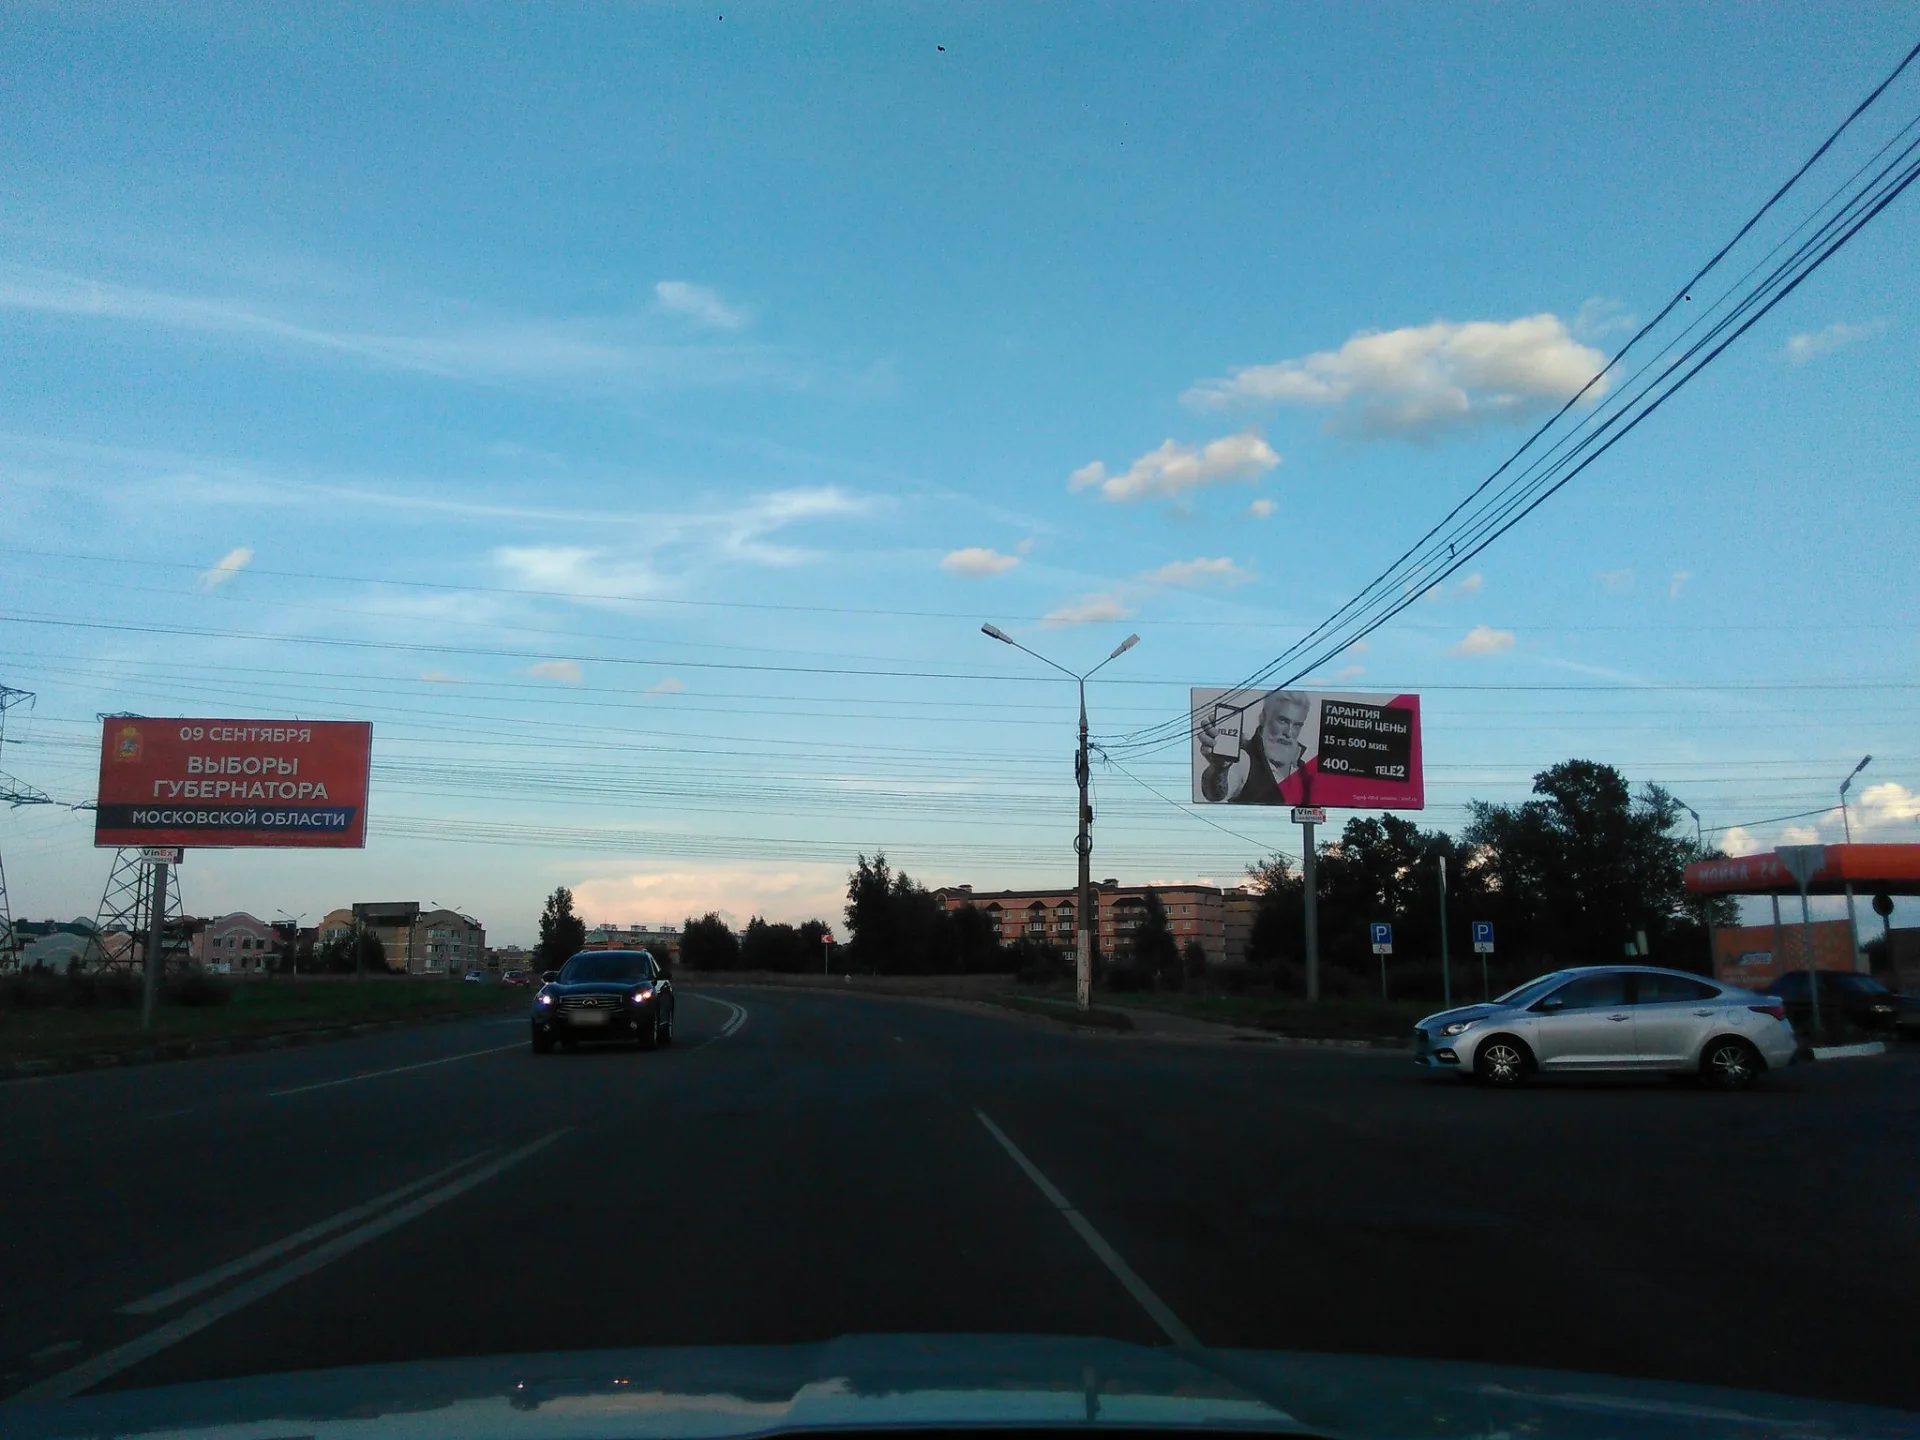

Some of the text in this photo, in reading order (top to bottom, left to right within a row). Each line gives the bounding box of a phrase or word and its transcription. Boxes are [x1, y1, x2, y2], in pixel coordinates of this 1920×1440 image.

[1325, 704, 1380, 719] ГАРАНТИЯ
[1325, 716, 1407, 734] ЛУЧШЕЙ ЦЕНЫ
[179, 726, 312, 743] 09 СЕНТЯБРЯ
[1324, 735, 1335, 745] 15
[1347, 738, 1367, 749] 500
[187, 756, 299, 775] ВЫБОРЫ
[1322, 758, 1349, 771] 400
[1374, 765, 1405, 777] TELE2
[153, 780, 329, 800] ГУБЕРНАТОРА
[132, 808, 345, 826] МОСКОВСКОЙ ОБЛАСТИ
[143, 849, 174, 857] VinEx
[1698, 860, 1779, 885] МОЙКА 24
[1376, 926, 1388, 942] P
[1477, 924, 1489, 941] P
